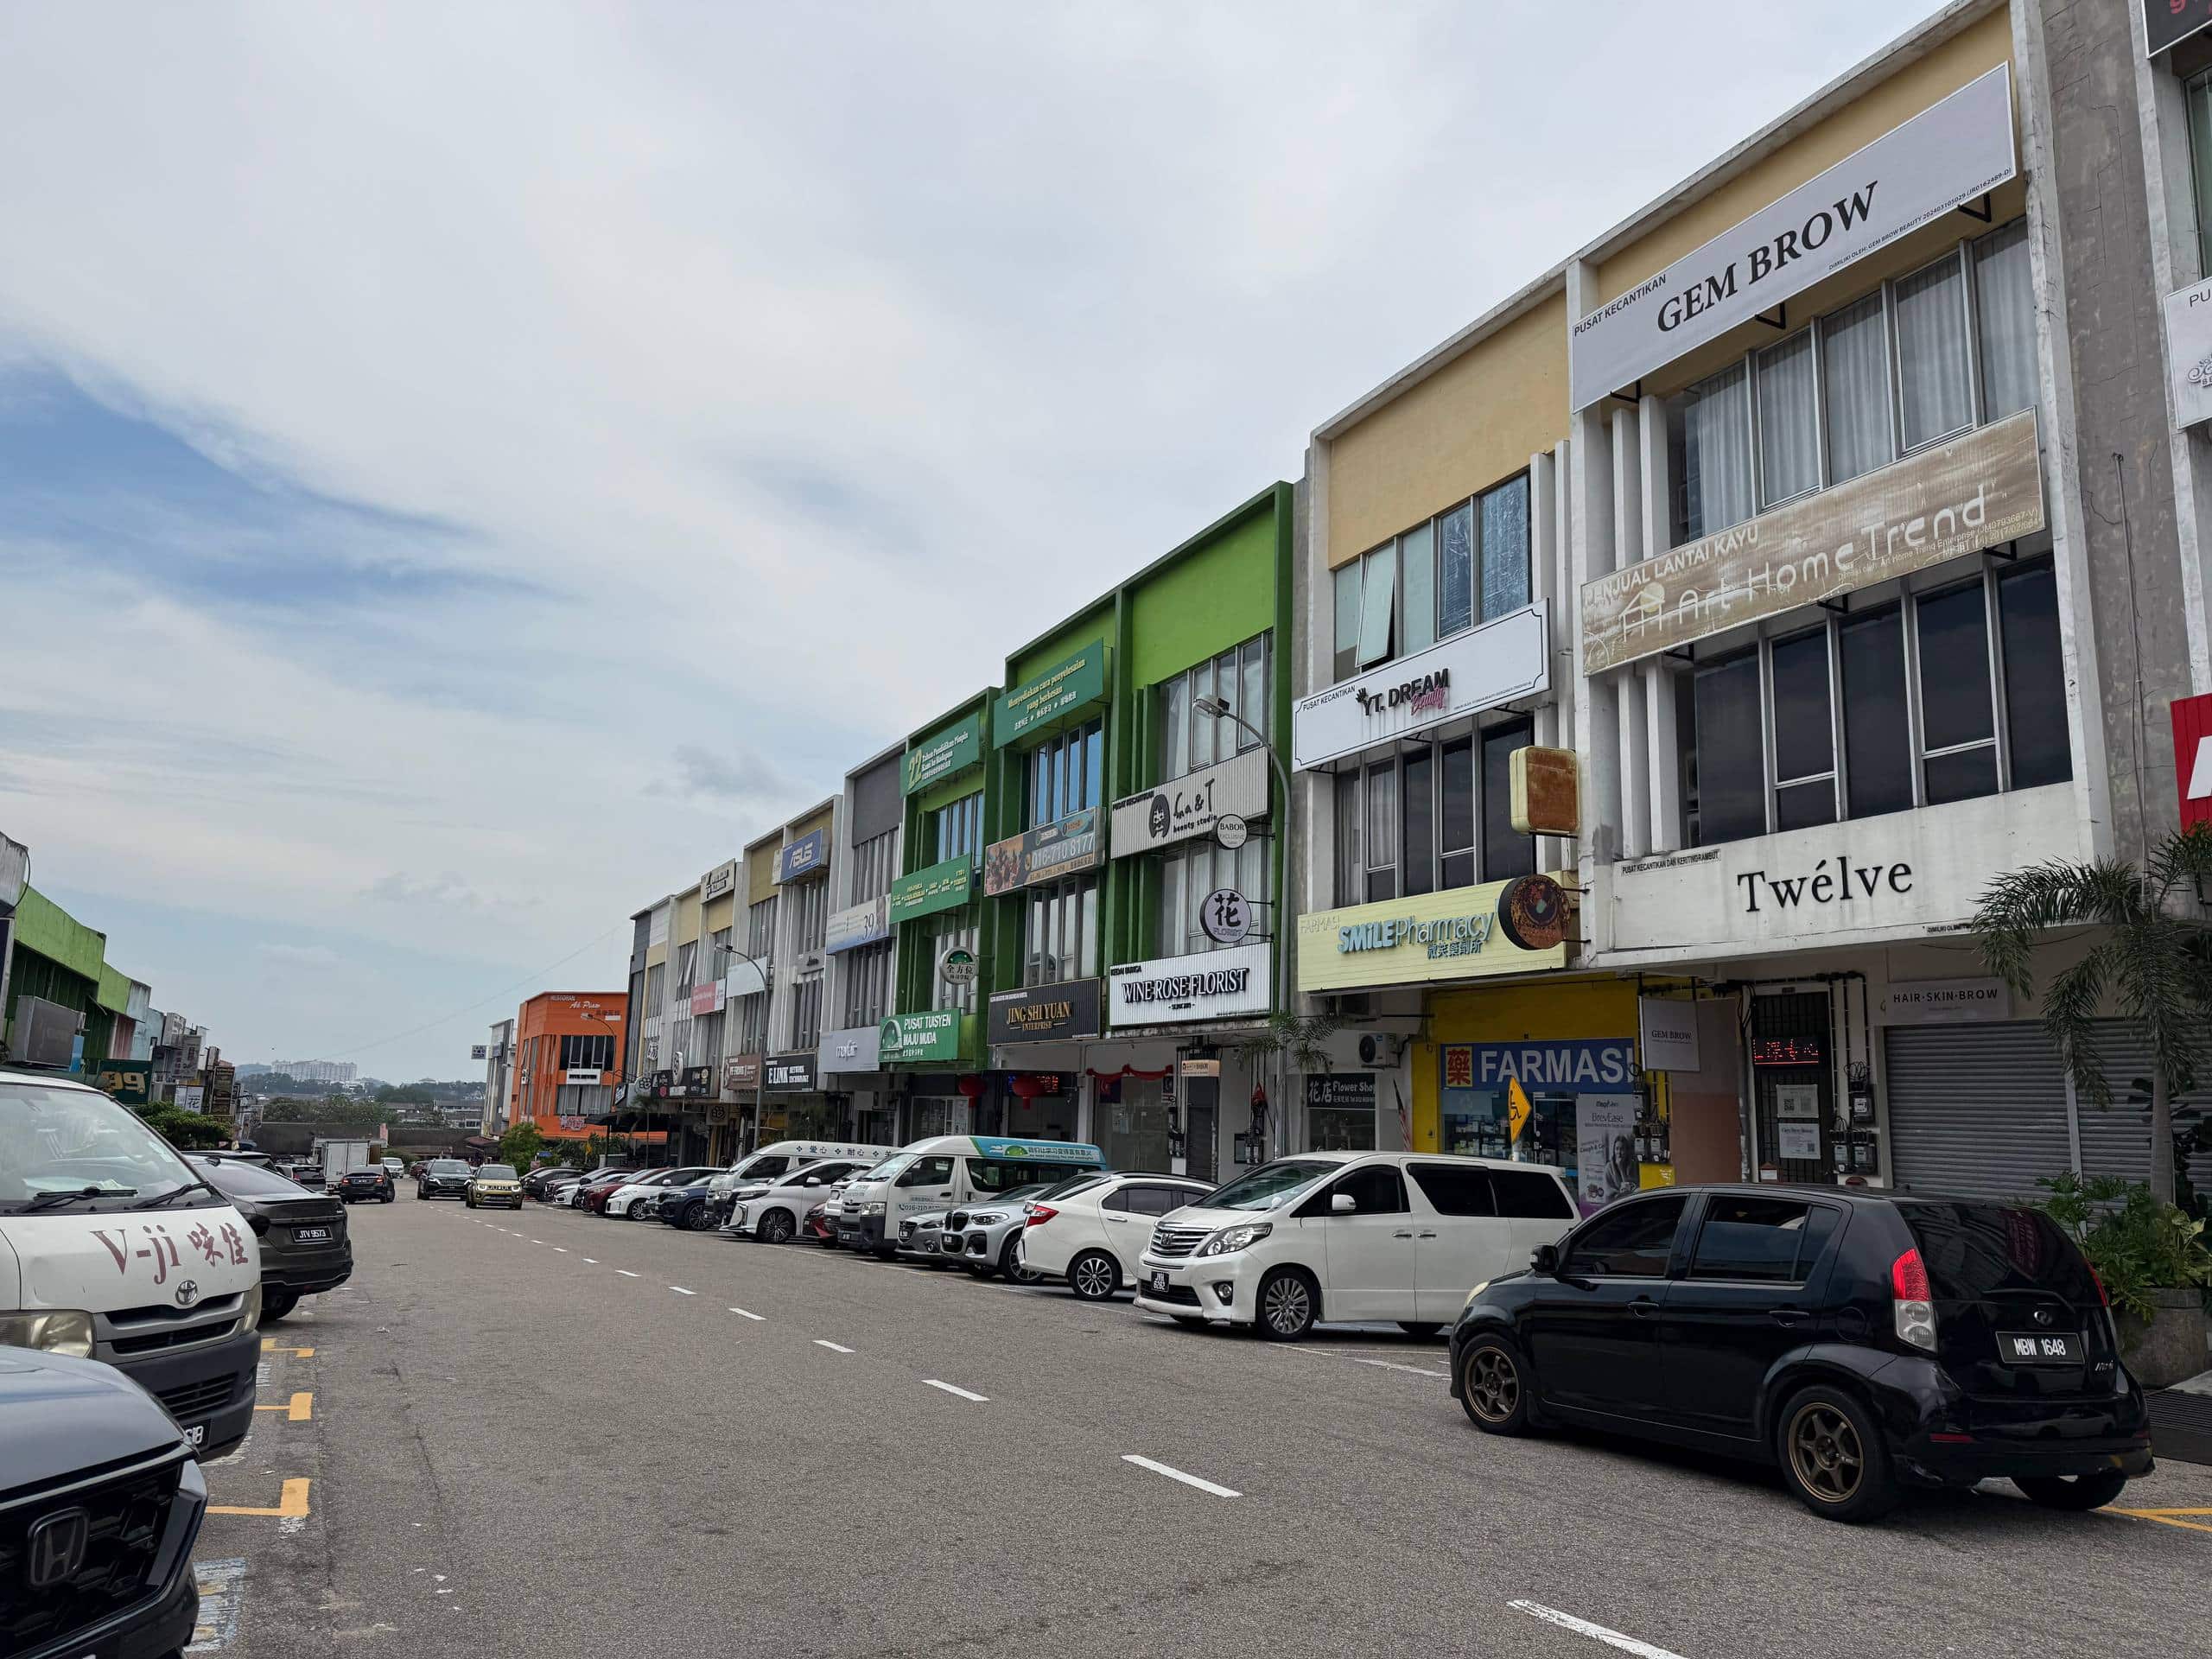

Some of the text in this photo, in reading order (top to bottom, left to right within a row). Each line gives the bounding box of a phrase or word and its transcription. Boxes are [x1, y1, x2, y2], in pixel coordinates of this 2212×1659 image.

[1868, 238, 1881, 250] GEM
[1881, 229, 1899, 243] BROW
[1899, 215, 1922, 233] BEAUTY
[1657, 180, 1878, 332] GEM BROW
[1574, 274, 1666, 337] PUSAT KECANTIKAN
[1655, 545, 1709, 578] LANTAI
[1714, 524, 1758, 557] KAYU
[1748, 542, 1854, 602] Home
[1859, 484, 1986, 561] Trend
[1892, 550, 1914, 563] Home
[1302, 685, 1356, 711] PUSAT KECANTIKAN
[1388, 668, 1450, 708] DREAM
[1219, 823, 1245, 831] BABOR
[1737, 856, 1913, 912] Twélve
[1214, 893, 1242, 927] 花
[1122, 968, 1249, 1003] WINE ROSE FLORIST
[904, 1013, 951, 1031] PUSAT TUISYEN
[1006, 1001, 1071, 1025] JING SHI YUAN
[1480, 1046, 1634, 1084] FARMASI
[1332, 1080, 1357, 1092] Flower
[89, 1224, 182, 1286] V-ji
[2012, 1338, 2066, 1356] MBW 1648
